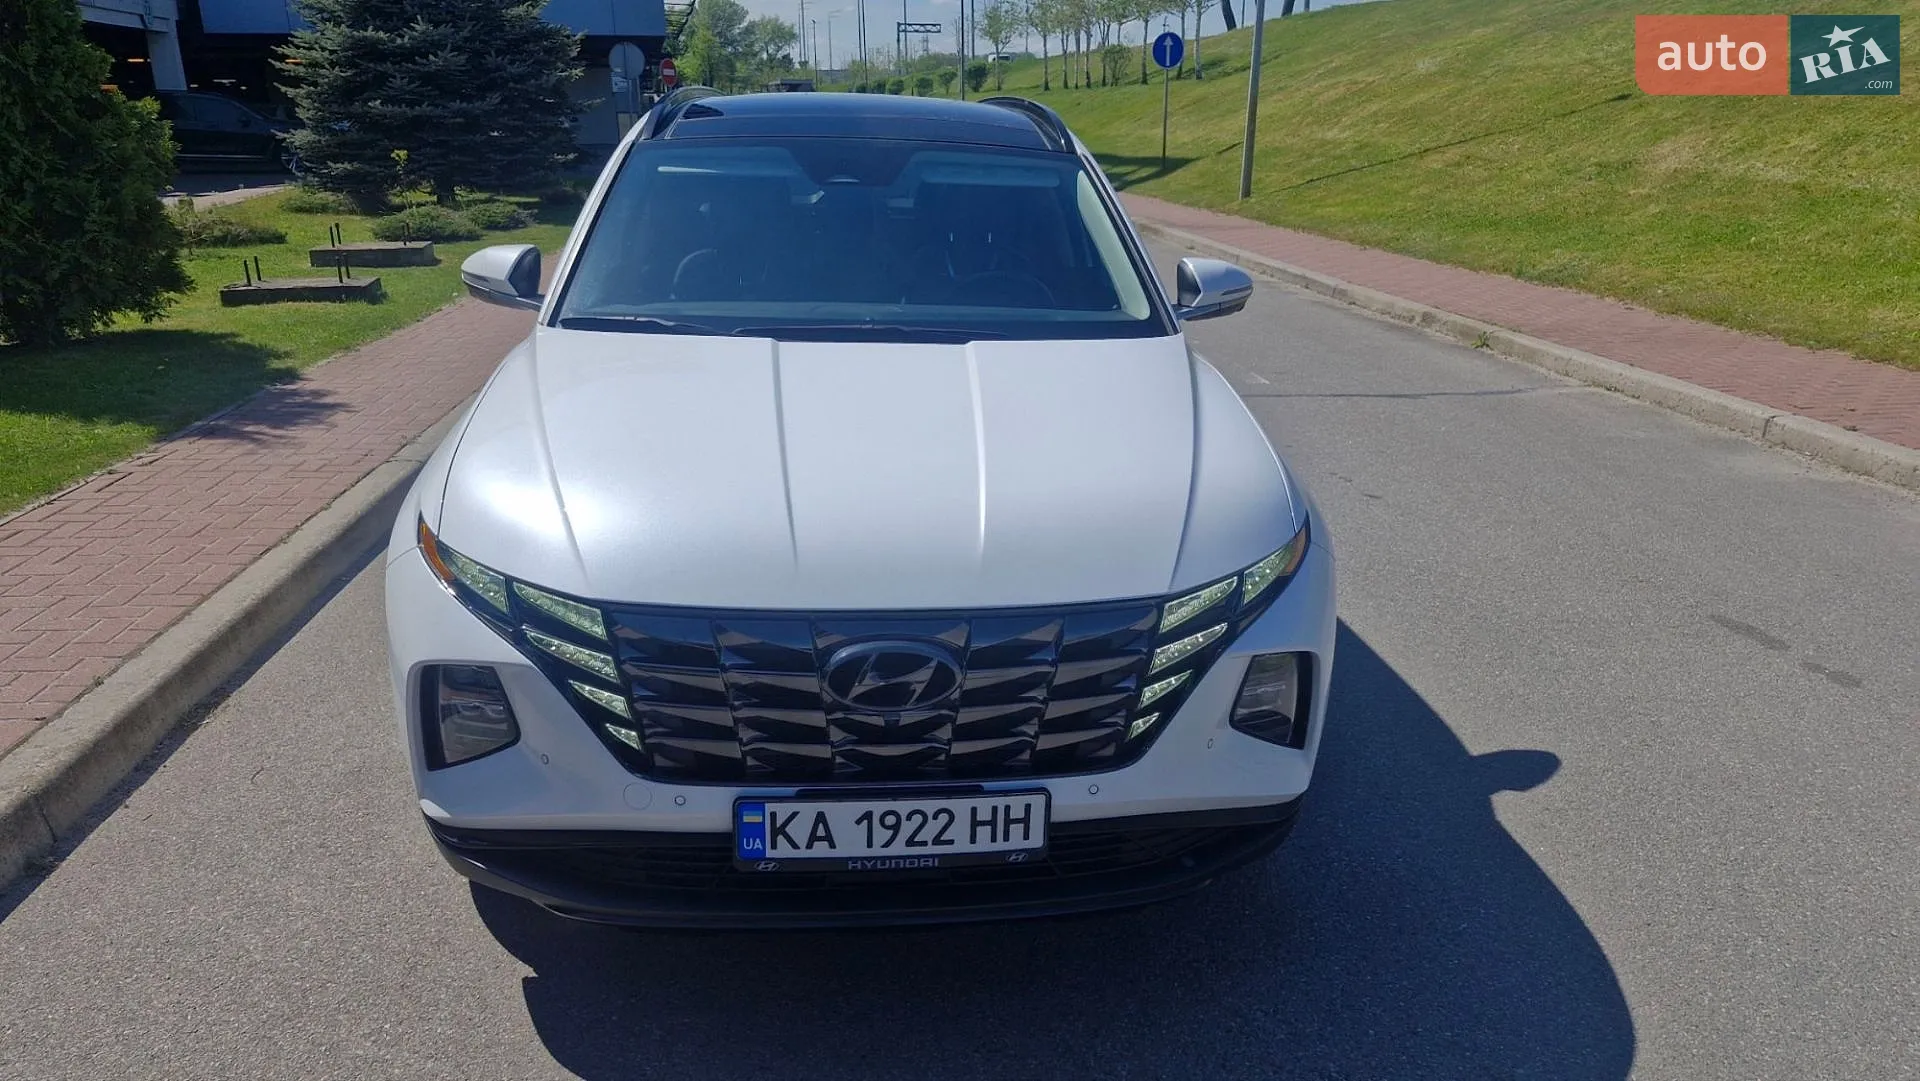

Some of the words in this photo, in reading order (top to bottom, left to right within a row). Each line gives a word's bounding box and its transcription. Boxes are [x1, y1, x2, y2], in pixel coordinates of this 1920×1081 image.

[769, 810, 837, 850] KA
[854, 808, 955, 849] 1922
[743, 837, 763, 850] UA
[848, 857, 939, 870] HYUNDAI
